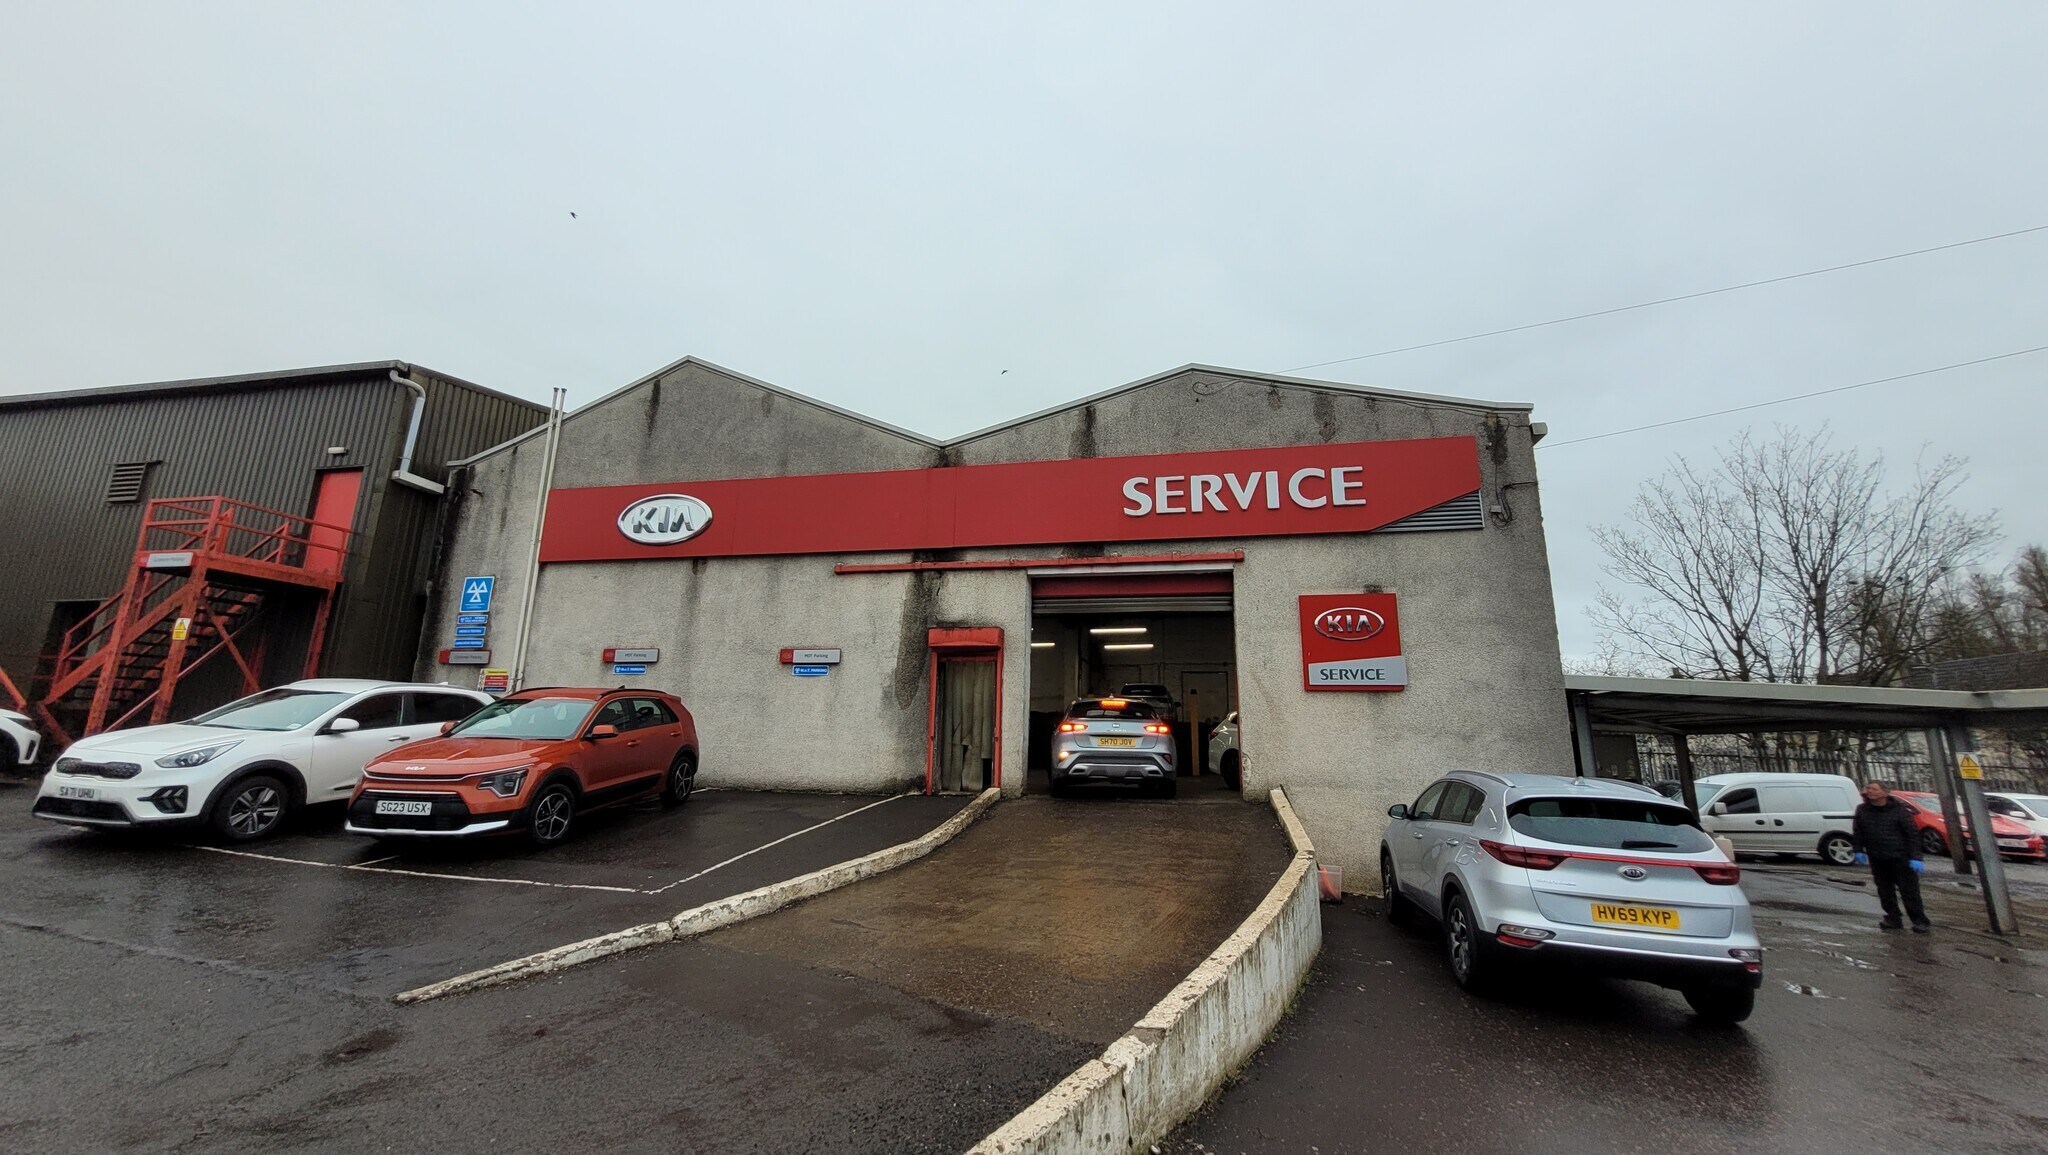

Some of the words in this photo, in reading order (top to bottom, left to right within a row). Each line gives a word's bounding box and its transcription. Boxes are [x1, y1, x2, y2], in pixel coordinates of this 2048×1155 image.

[1122, 466, 1367, 517] SERVICE
[631, 504, 695, 534] KIA
[1326, 614, 1373, 632] KIA
[1320, 668, 1386, 681] SERVICE
[380, 802, 405, 813] SG23
[407, 803, 427, 813] USX
[1597, 905, 1638, 921] HV69
[1641, 909, 1672, 925] KYP
